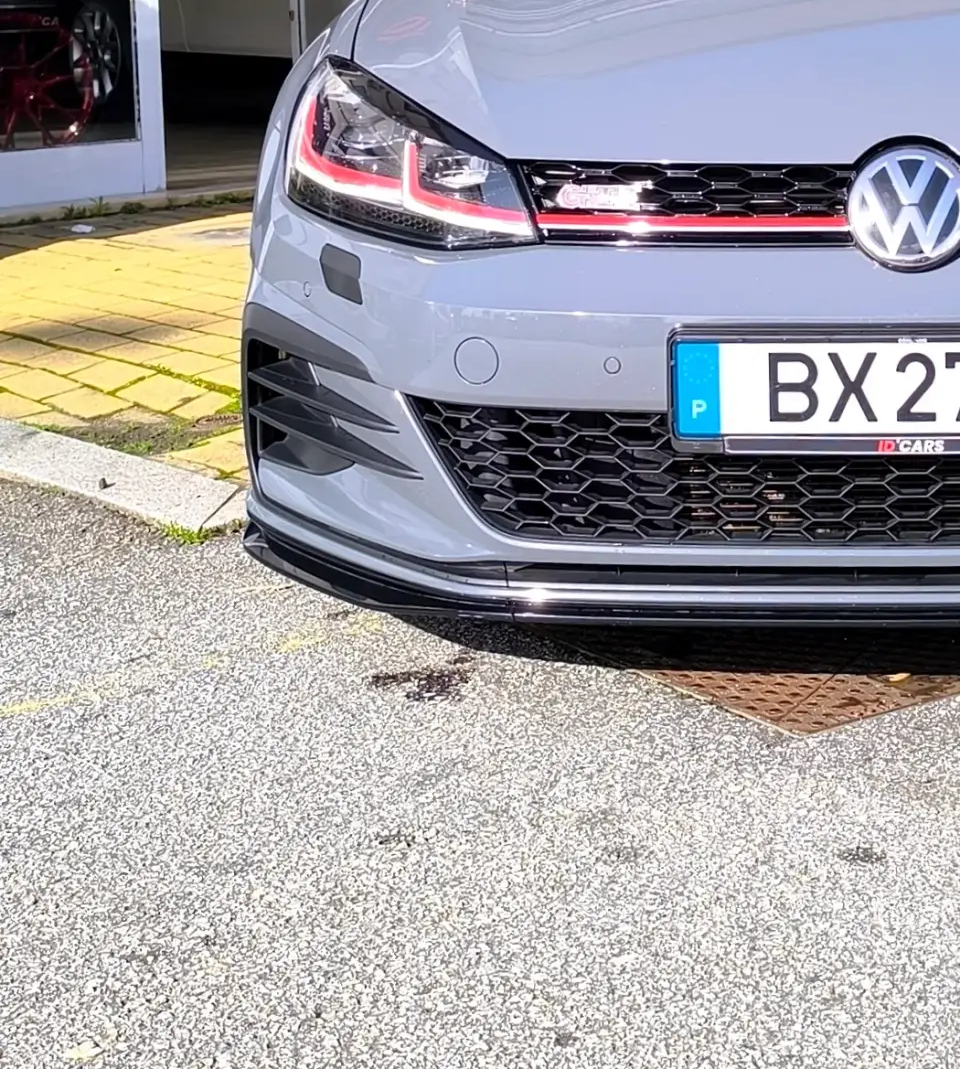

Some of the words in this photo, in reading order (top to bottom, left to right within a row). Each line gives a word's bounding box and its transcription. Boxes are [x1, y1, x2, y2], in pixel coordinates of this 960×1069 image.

[768, 351, 878, 423] BX
[691, 399, 707, 418] P
[878, 438, 945, 453] ID'CARS
